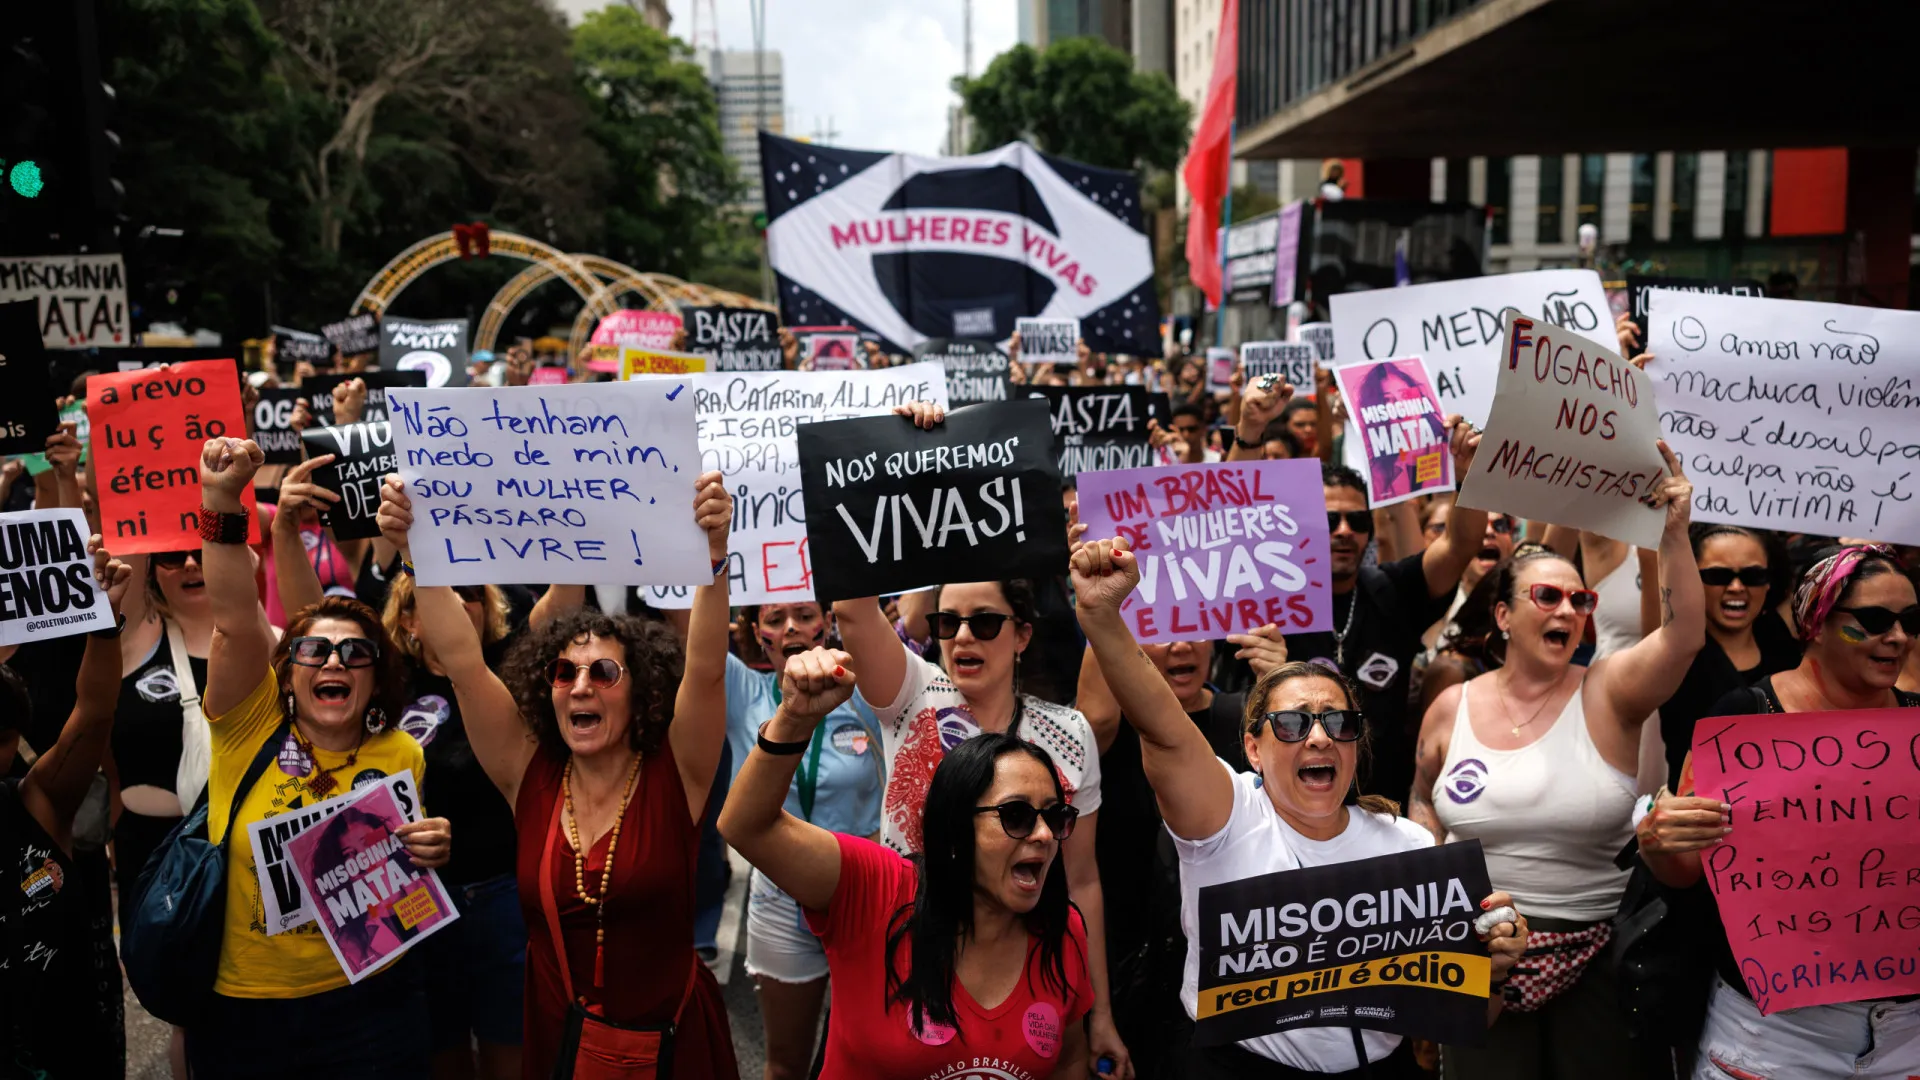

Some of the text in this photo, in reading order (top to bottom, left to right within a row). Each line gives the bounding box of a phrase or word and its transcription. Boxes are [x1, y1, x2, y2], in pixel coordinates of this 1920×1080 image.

[829, 216, 1098, 297] MULHERES VIVAS
[35, 294, 122, 340] ATA!
[695, 310, 770, 344] BASTA
[1363, 318, 1398, 360] O
[1543, 289, 1598, 332] NÃO
[391, 332, 457, 349] MATA
[693, 347, 781, 370] MINICÍDIO!
[1020, 334, 1075, 354] VIVAS!
[1246, 346, 1311, 360] MULHERES
[1720, 333, 1800, 360] amor
[1810, 320, 1881, 365] não
[1438, 366, 1465, 398] Ai
[1508, 317, 1638, 408] FOGACHO
[101, 377, 205, 404] a revo
[1360, 396, 1435, 424] MISOGINIA
[1664, 371, 1920, 415] machuca, violên
[403, 398, 628, 437] Não tenham
[1555, 398, 1617, 440] NOS
[1659, 410, 1717, 440] não
[1725, 416, 1763, 446] é
[408, 443, 493, 467] medo
[514, 440, 550, 465] de
[825, 436, 1019, 488] NOS QUEREMOS
[1057, 440, 1149, 478] MINICÍDIO!
[413, 478, 472, 498] SOU
[1692, 453, 1785, 485] culpa
[1796, 466, 1854, 493] não
[1872, 472, 1912, 501] é
[430, 505, 586, 526] PÁSSARO
[835, 476, 1026, 564] VIVAS!
[1105, 483, 1155, 522] UM
[1695, 487, 1738, 516] da
[0, 519, 86, 570] UMA
[1115, 504, 1299, 551] DE MULHERES
[445, 538, 607, 563] LIVRE
[0, 563, 95, 621] ENOS
[1698, 722, 1890, 774] TODOS
[315, 833, 404, 895] MISOGINIA
[1859, 848, 1920, 889] PER
[325, 857, 421, 928] MATA.
[1220, 877, 1473, 947] MISOGINIA
[1747, 905, 1920, 941] INSTAG
[1219, 919, 1469, 976] NÃO É OPINIÃO
[1215, 954, 1466, 1011] red pill é ódio
[1741, 951, 1920, 1012] @CRiKAGU
[1028, 1012, 1045, 1020] PELA
[1028, 1021, 1044, 1029] VIDA
[923, 1061, 966, 1080] NIÃO
